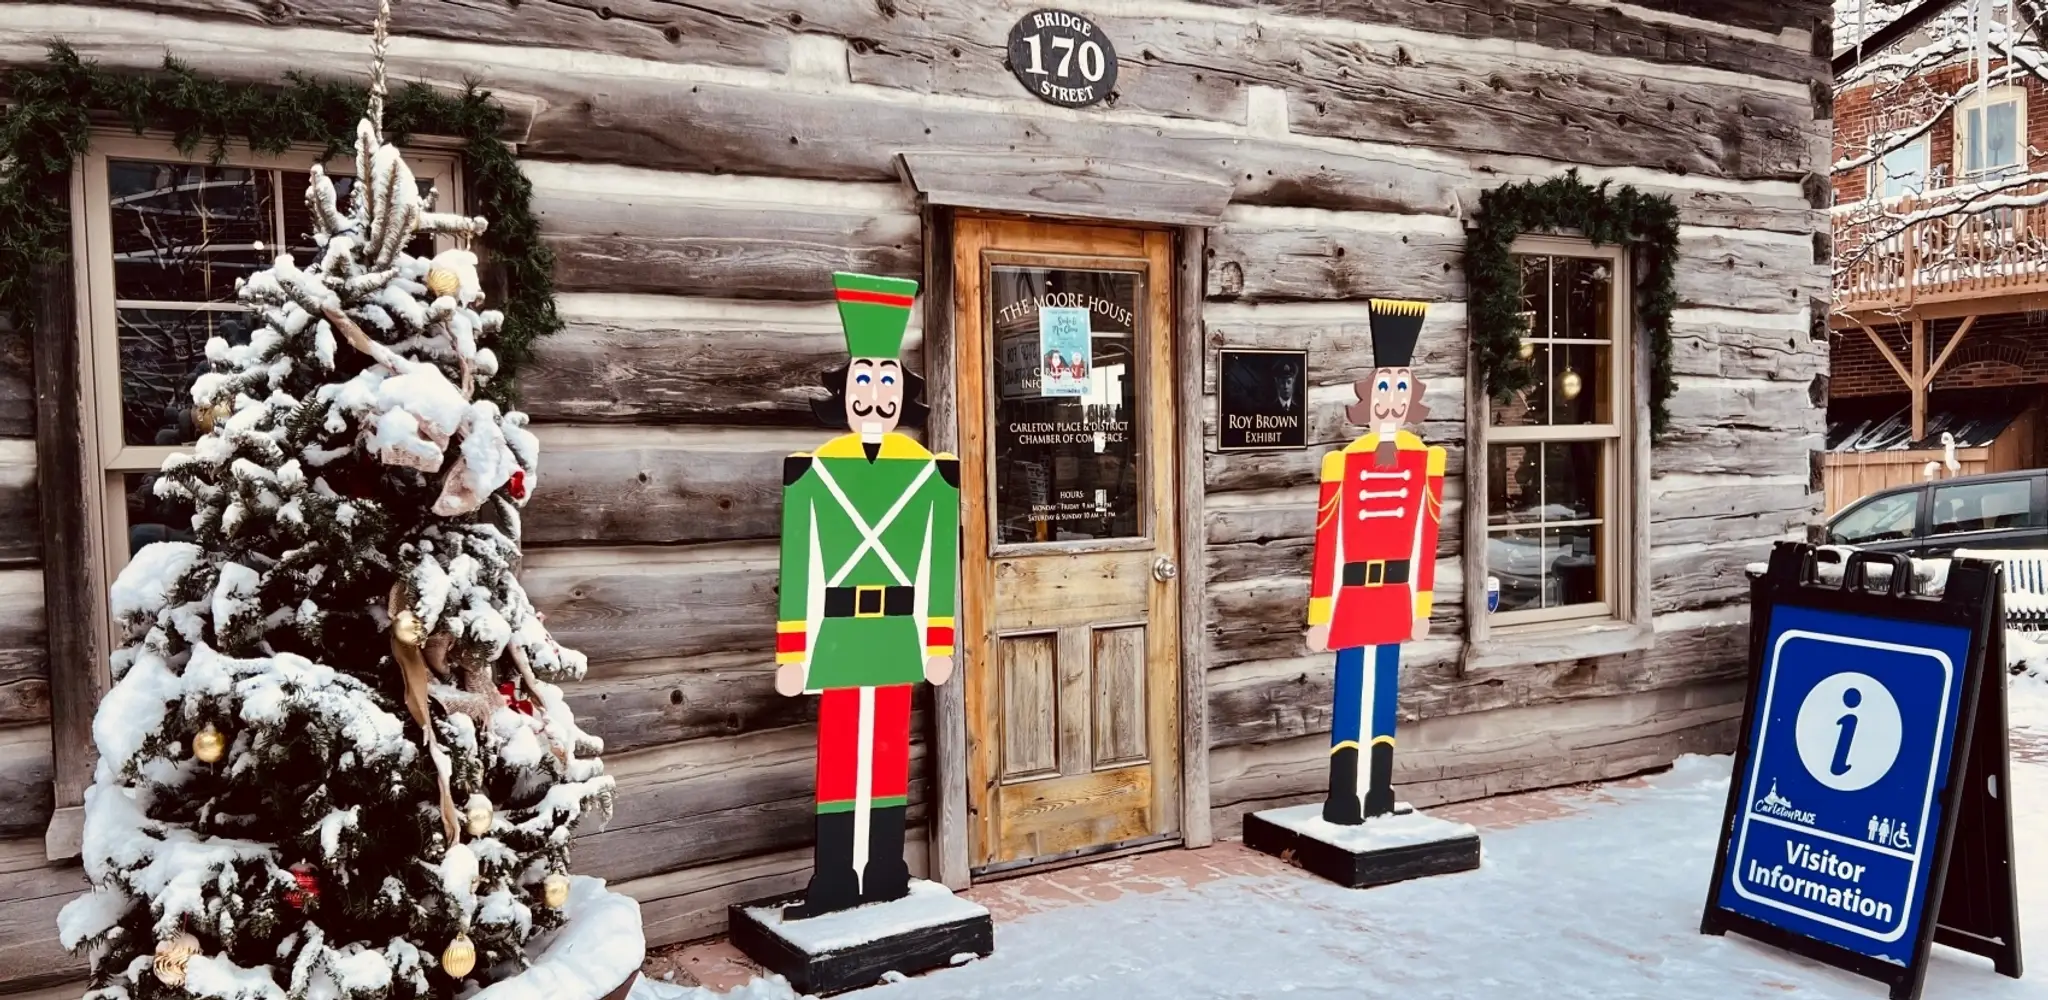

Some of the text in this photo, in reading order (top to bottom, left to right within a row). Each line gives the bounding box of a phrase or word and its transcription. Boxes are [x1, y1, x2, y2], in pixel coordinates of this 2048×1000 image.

[1033, 12, 1092, 37] BRIDGE
[1022, 33, 1105, 82] 170
[1041, 80, 1094, 102] STREET
[1000, 299, 1029, 323] THE
[1033, 292, 1084, 308] MOORE
[1088, 296, 1133, 327] HOUSE
[1010, 422, 1054, 432] CARLETON
[1057, 422, 1081, 432] PLACE
[1091, 421, 1128, 431] DISTRICT
[1229, 414, 1298, 429] ROY BROWN
[1019, 434, 1061, 444] CHAMBER
[1063, 434, 1074, 443] OF
[1245, 431, 1282, 443] EXHIBIT
[1032, 504, 1057, 512] MONDAY
[1028, 514, 1055, 522] SATURDAY
[1786, 840, 1866, 883] Visitor
[1748, 859, 1893, 923] Information
